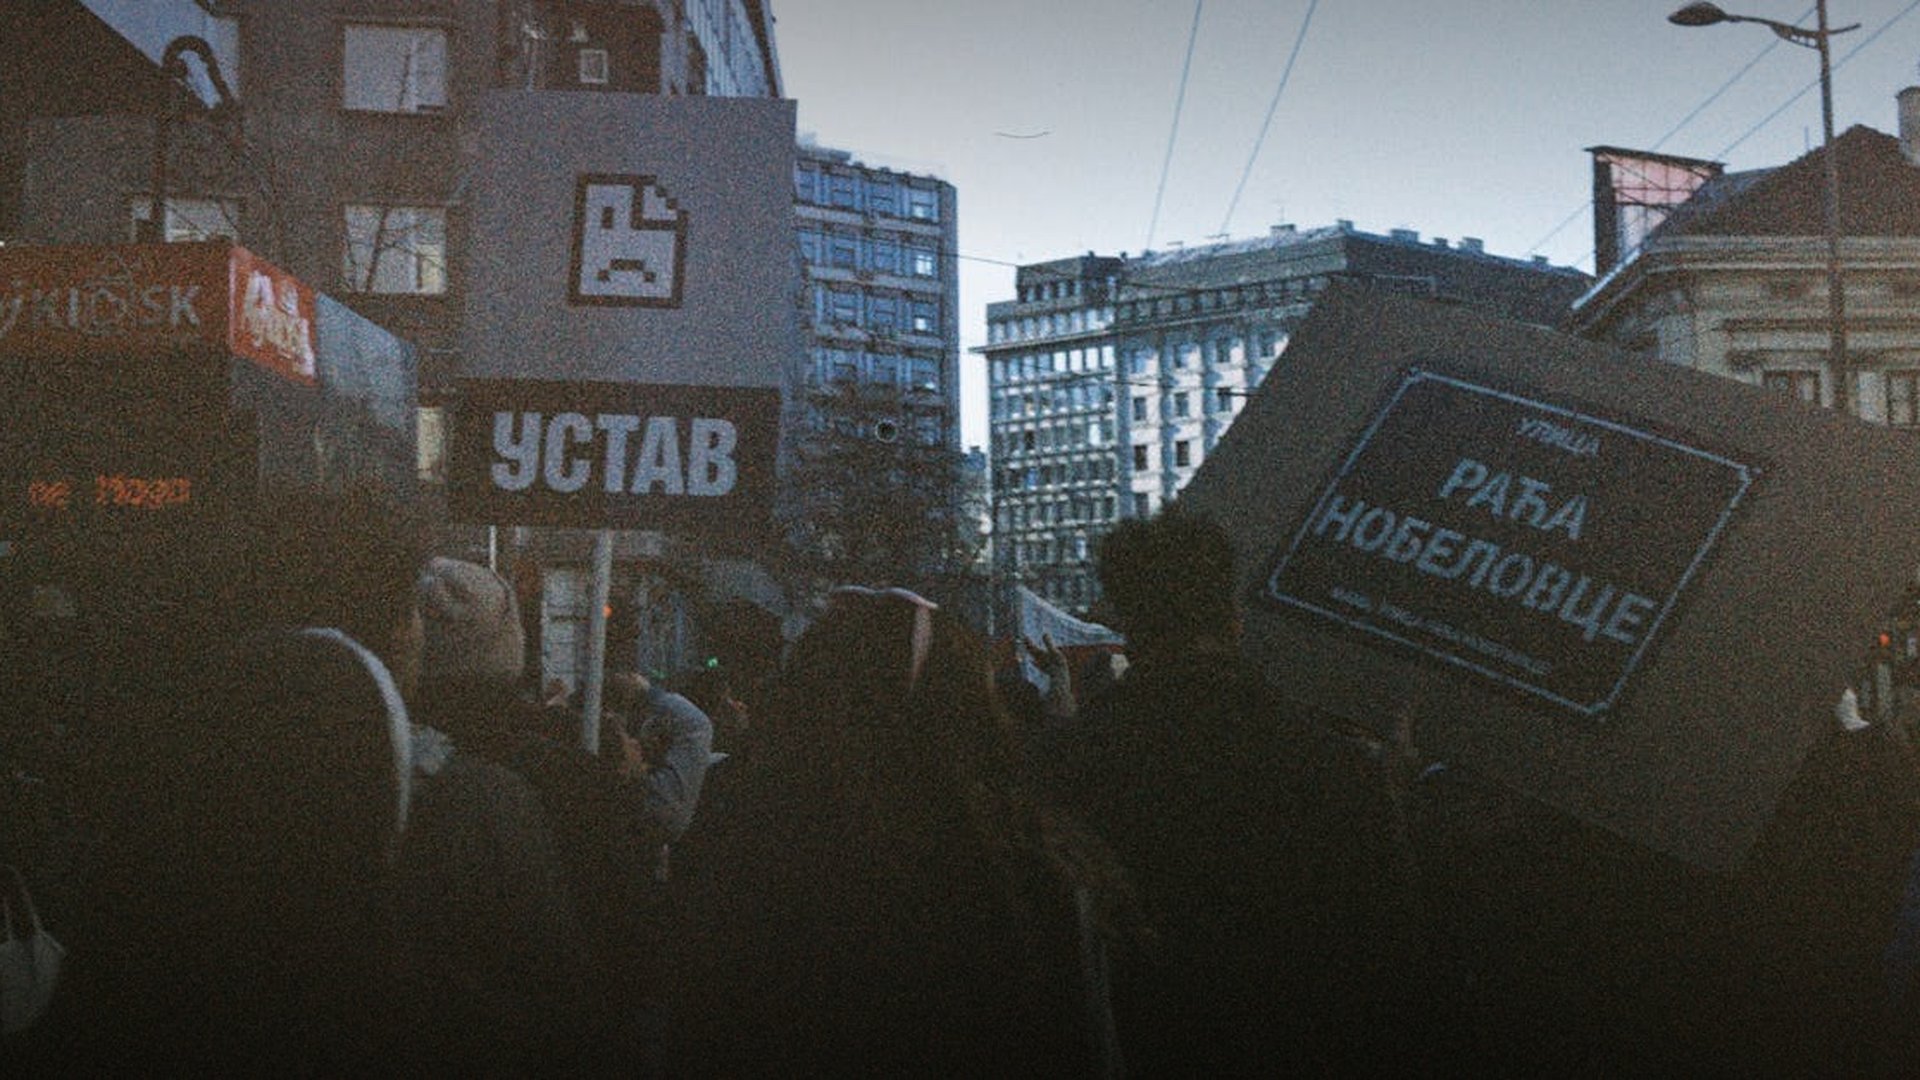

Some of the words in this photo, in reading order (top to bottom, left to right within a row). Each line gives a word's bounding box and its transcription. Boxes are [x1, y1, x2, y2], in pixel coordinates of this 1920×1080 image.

[491, 411, 738, 497] УСТАВ
[1438, 457, 1588, 541] РАЂА
[1314, 495, 1657, 643] НОБЕЛОВЦЕ
